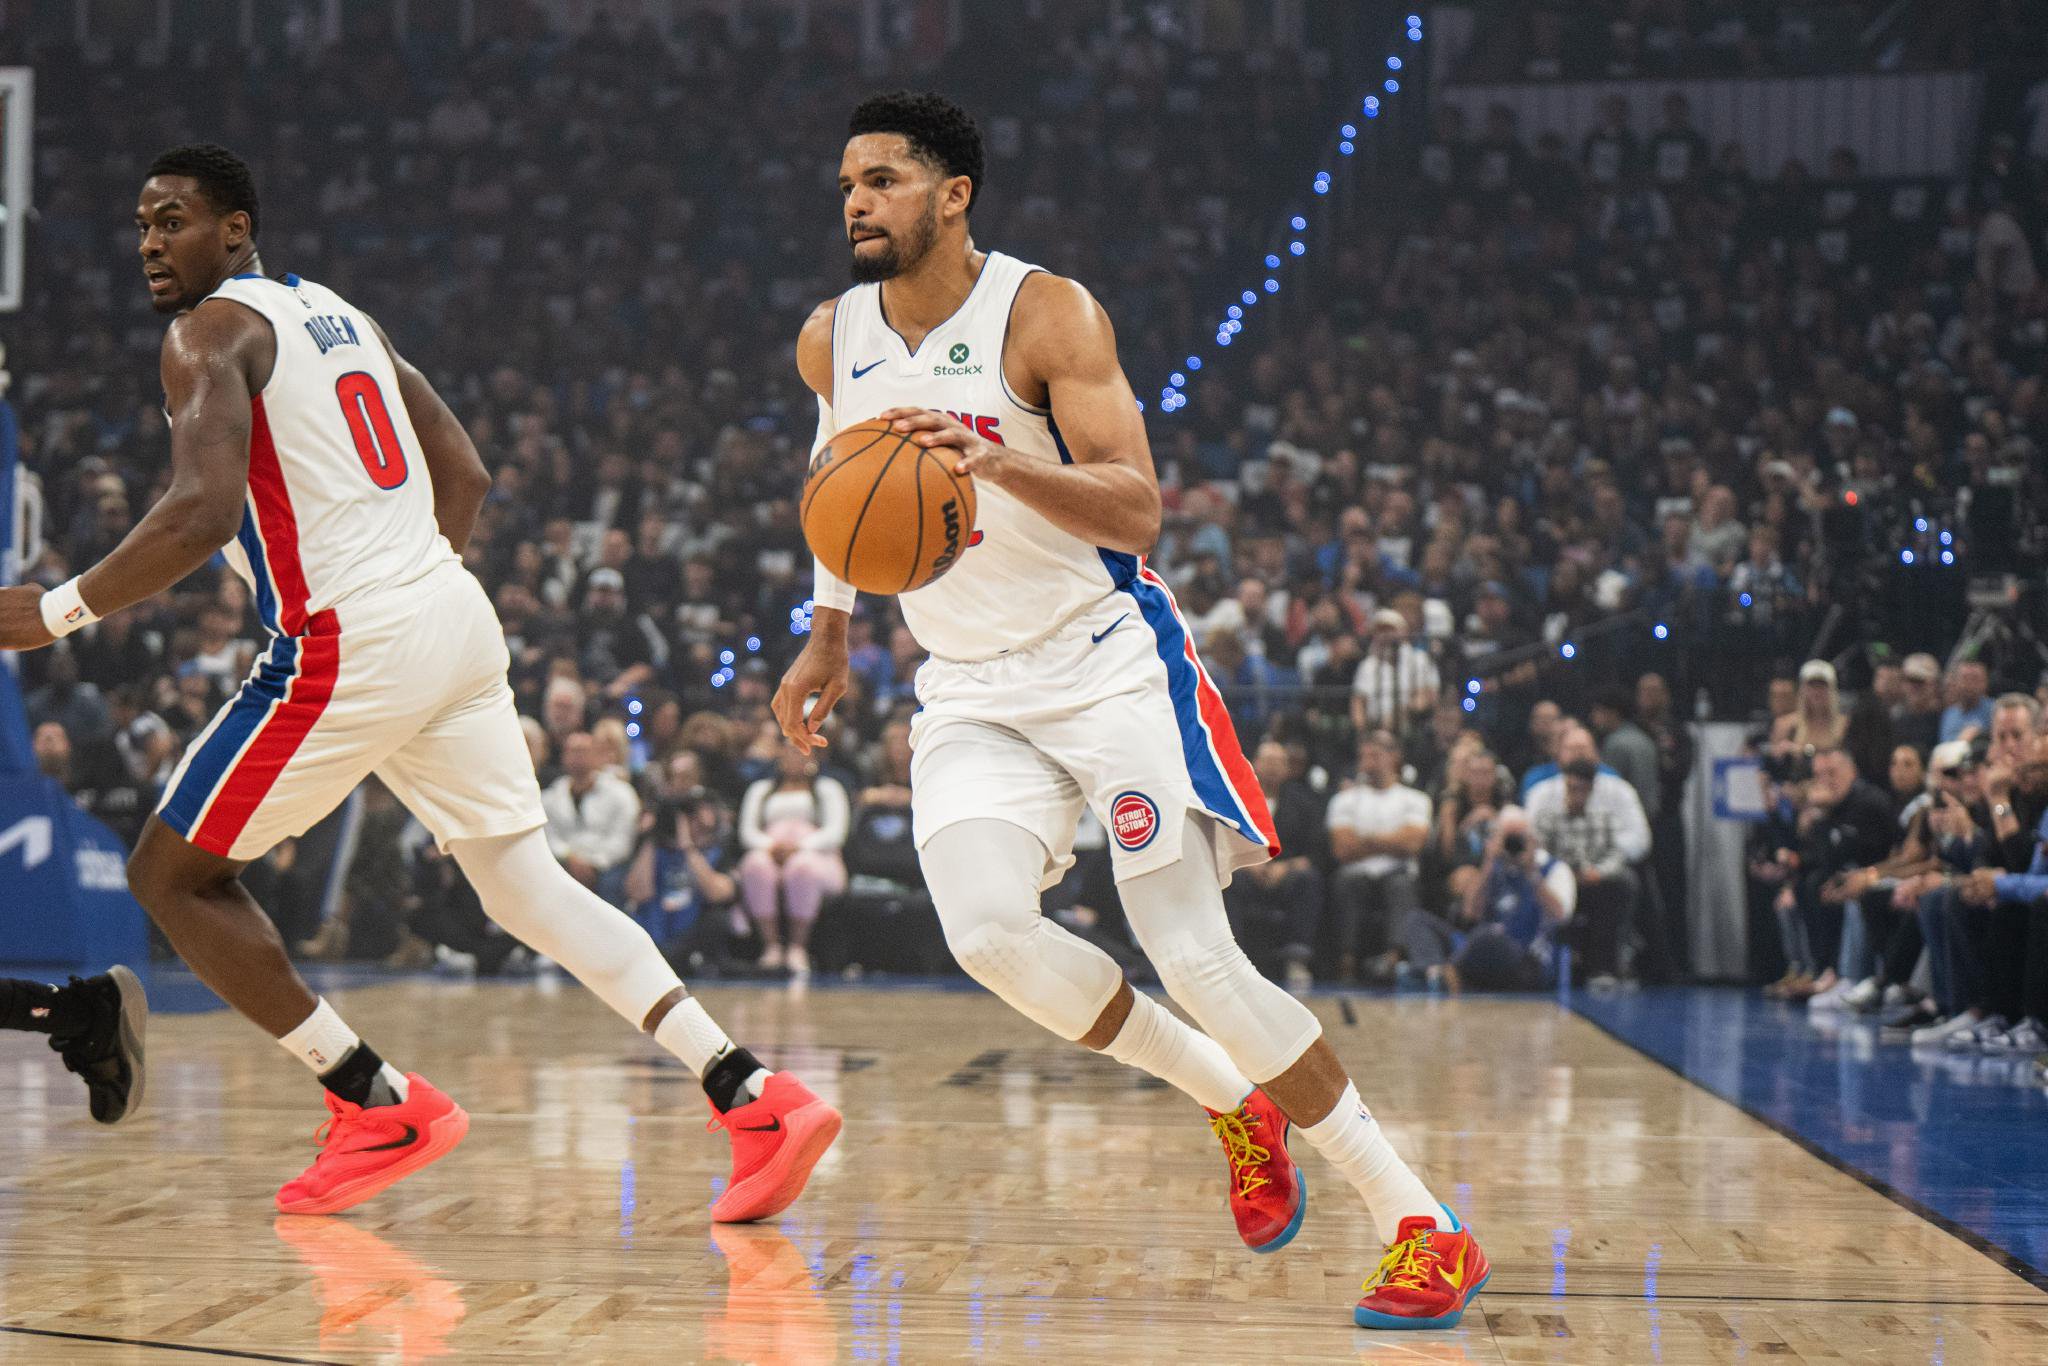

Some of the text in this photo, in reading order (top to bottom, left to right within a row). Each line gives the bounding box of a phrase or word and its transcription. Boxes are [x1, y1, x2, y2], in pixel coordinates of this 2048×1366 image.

[304, 314, 361, 355] DUREN
[933, 364, 983, 376] StockX
[335, 371, 409, 490] 0
[1117, 808, 1146, 824] DETROIT
[1119, 818, 1149, 834] PISTONS
